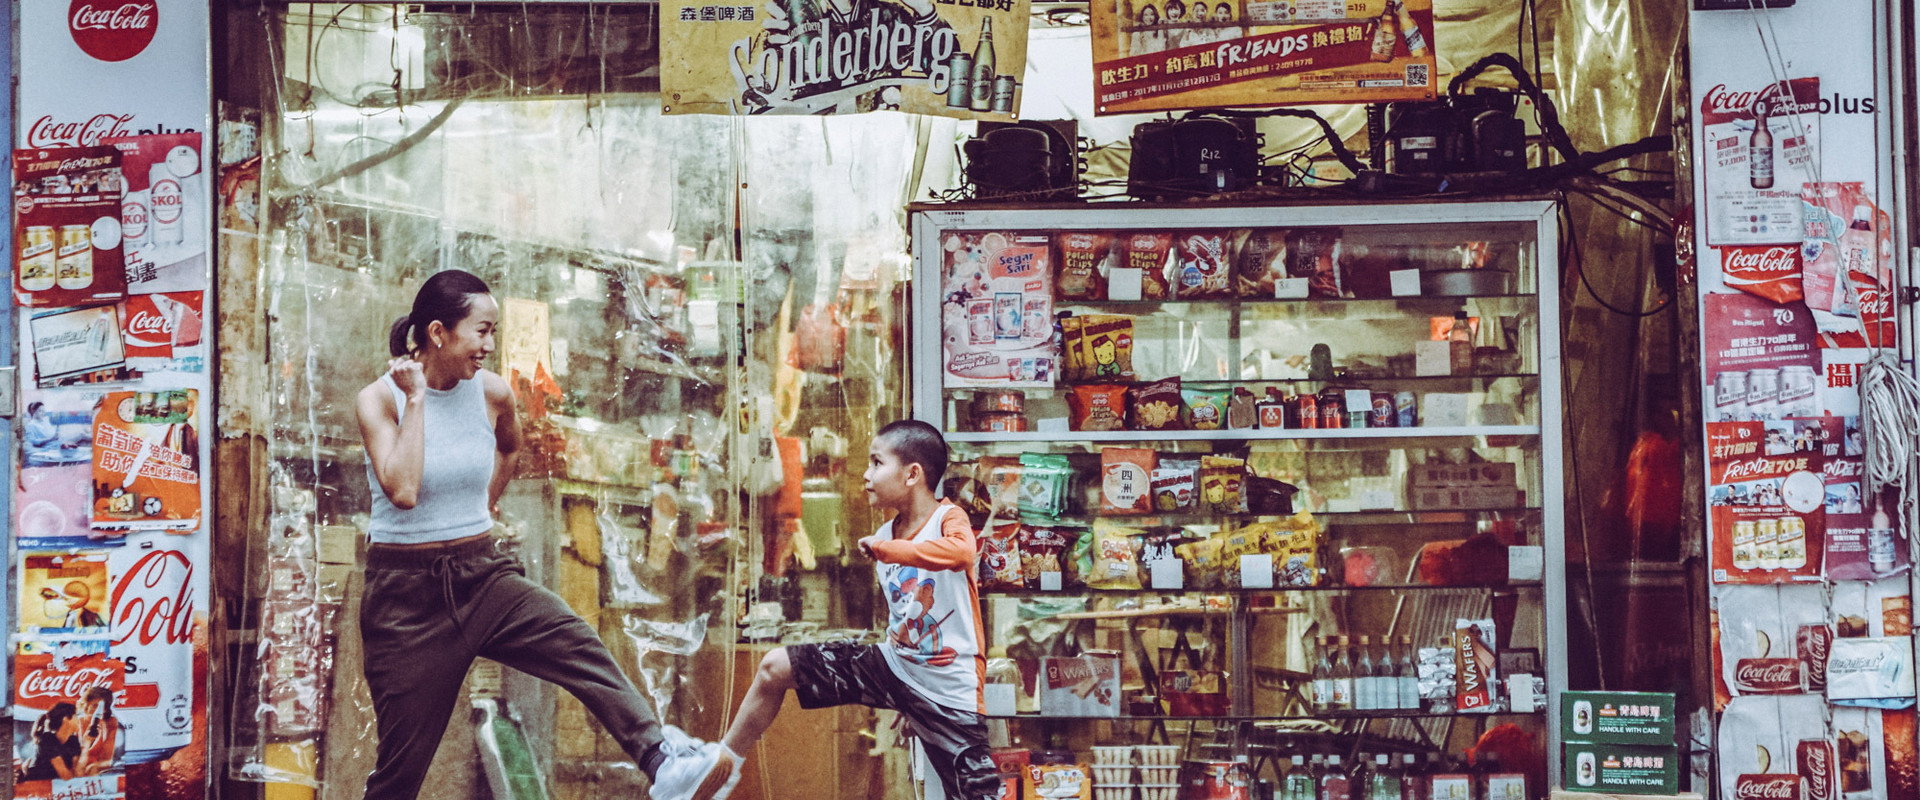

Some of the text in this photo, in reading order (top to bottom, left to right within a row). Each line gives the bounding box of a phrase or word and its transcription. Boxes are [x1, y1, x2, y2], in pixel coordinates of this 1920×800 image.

[72, 3, 153, 30] Coca-Cola
[681, 7, 754, 21] 森堡啤酒
[729, 8, 957, 97] Sonderberg
[151, 195, 182, 206] SKOL
[1000, 253, 1034, 265] Segar
[1066, 251, 1094, 260] Potato
[1130, 251, 1158, 260] Potato
[1725, 247, 1799, 272] Coca-Cola
[1007, 262, 1030, 274] Sari
[1462, 635, 1480, 692] WAFERS
[1808, 633, 1826, 685] Coca-Cola
[1737, 664, 1793, 683] Coca-Cola
[1603, 777, 1628, 785] HANDLE
[1646, 778, 1664, 786] CARE
[1737, 779, 1794, 799] Coca-Cola
